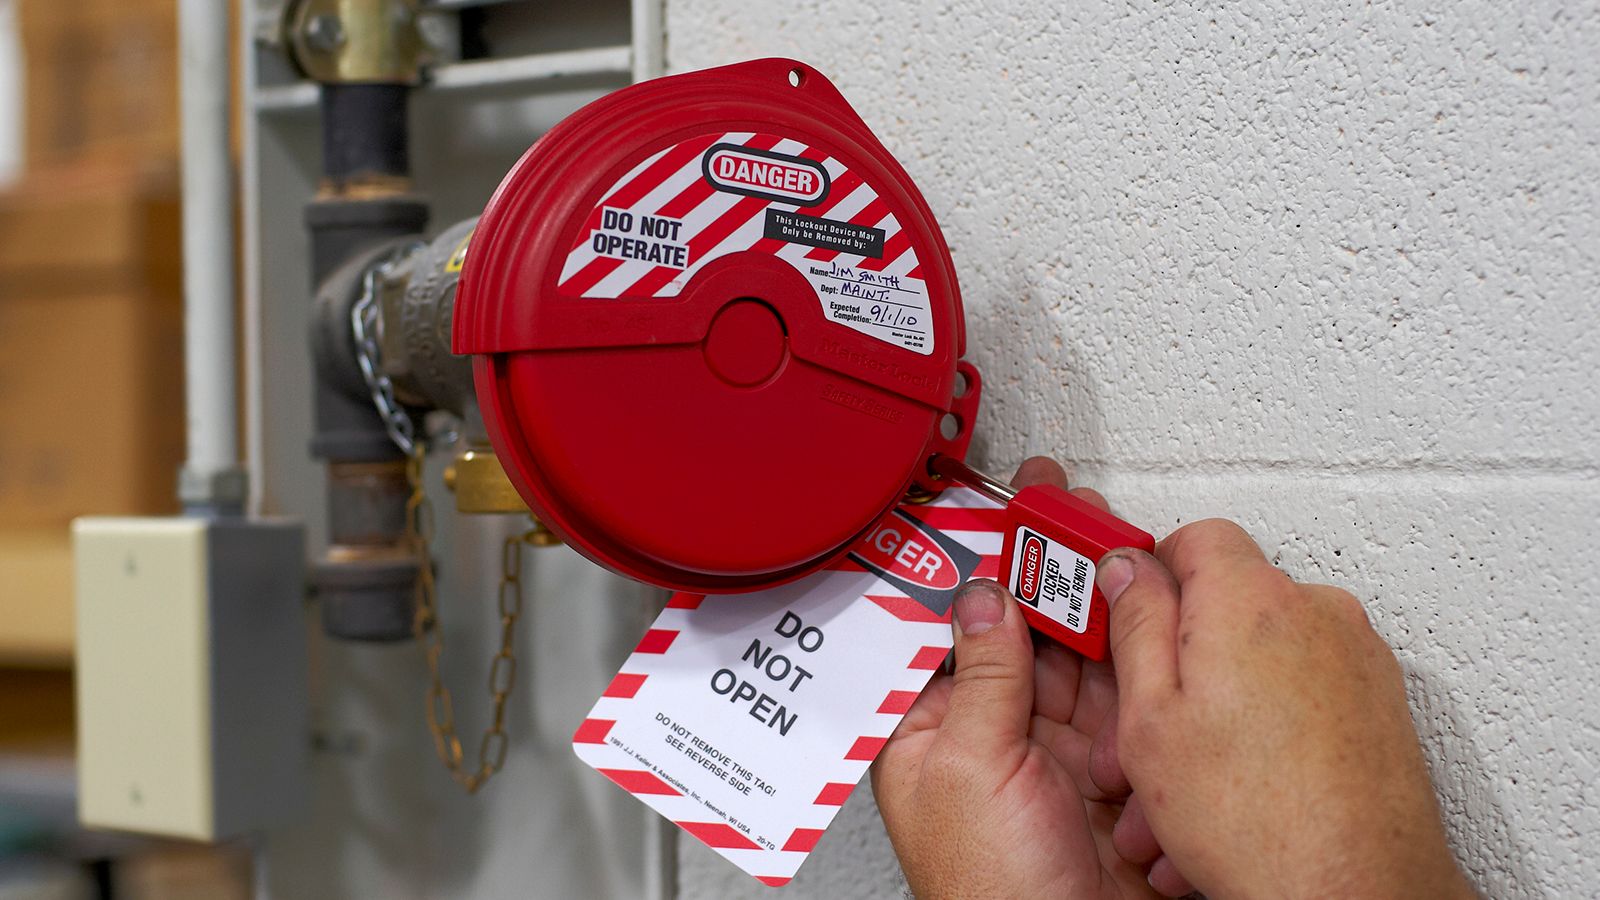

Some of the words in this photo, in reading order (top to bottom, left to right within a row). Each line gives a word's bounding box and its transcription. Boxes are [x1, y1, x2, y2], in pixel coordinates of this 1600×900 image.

[720, 157, 812, 193] DANGER
[603, 210, 633, 232] DO
[640, 216, 682, 241] NOT
[776, 215, 792, 226] This
[795, 219, 827, 232] Lockout
[830, 225, 856, 237] Device
[859, 231, 876, 242] May
[782, 226, 800, 238] Only
[803, 230, 813, 239] be
[816, 233, 851, 246] Removed
[854, 239, 866, 250] by:
[593, 233, 686, 267] OPERATE
[820, 284, 838, 295] Dept:
[829, 261, 854, 278] JIM
[859, 271, 900, 290] SMITH
[830, 301, 860, 313] Expected
[840, 282, 890, 301] MAINT.
[833, 311, 872, 324] Completion:
[870, 305, 918, 326] 9/1/10
[1023, 545, 1039, 593] DANGER
[1042, 558, 1060, 602] LOCKED
[1072, 558, 1089, 594] REMOVE
[1056, 573, 1071, 599] OUT
[1069, 594, 1083, 613] NOT
[774, 610, 824, 653] DO
[1066, 612, 1080, 628] DO
[741, 638, 814, 693] NOT
[710, 668, 798, 737] OPEN
[655, 712, 670, 726] DO
[670, 722, 692, 739] NOT
[691, 736, 732, 767] REMOVE
[732, 759, 753, 781] THIS
[753, 775, 777, 797] TAG!
[665, 734, 684, 751] SEE
[685, 749, 730, 781] REVERSE
[728, 777, 752, 796] SIDE
[609, 736, 624, 748] 1991
[634, 754, 653, 769] Keller
[657, 769, 690, 795] Associates,
[703, 800, 728, 820] Neenah,
[728, 815, 738, 825] WI
[737, 821, 751, 835] USA
